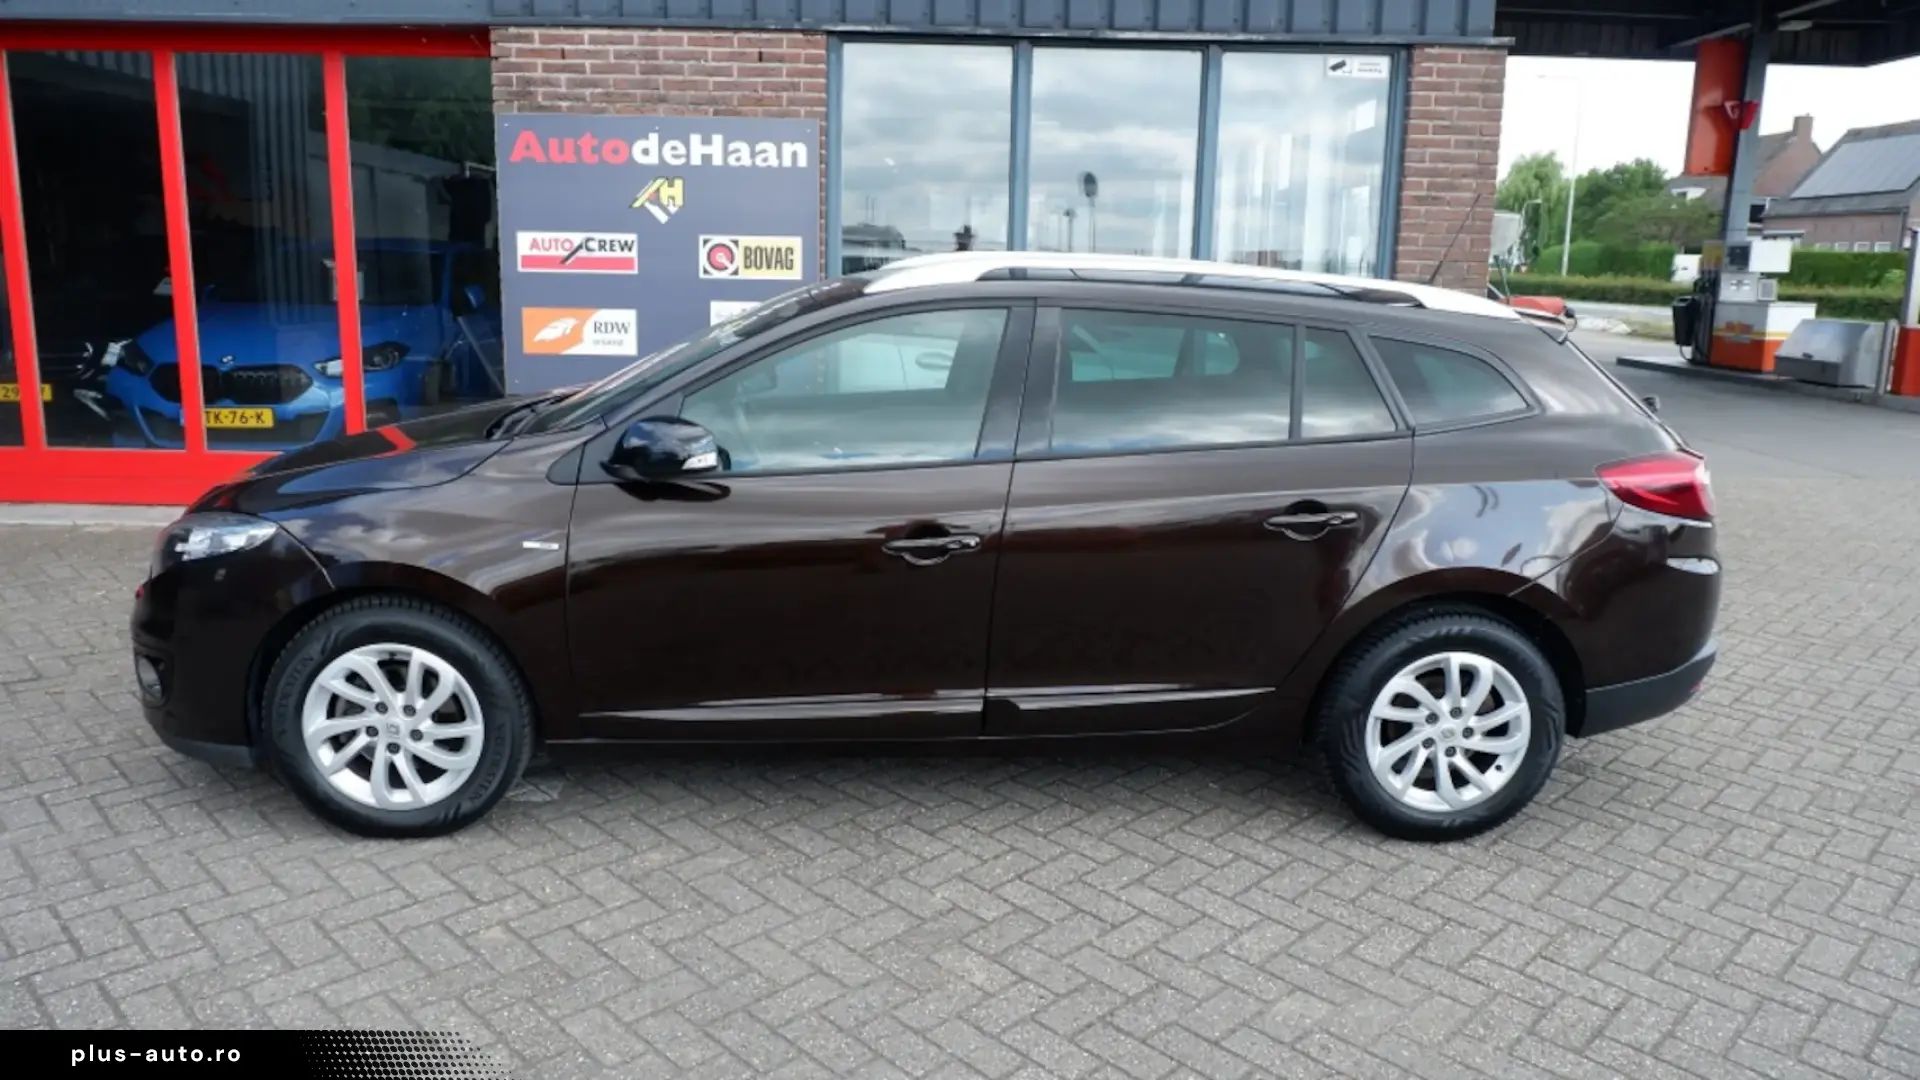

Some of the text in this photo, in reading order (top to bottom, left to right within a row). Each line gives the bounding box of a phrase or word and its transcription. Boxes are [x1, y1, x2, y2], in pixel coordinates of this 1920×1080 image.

[529, 236, 635, 252] AUTO CREW
[743, 245, 795, 270] BOVAG
[593, 320, 631, 334] RDW
[205, 410, 266, 425] TK-76-K
